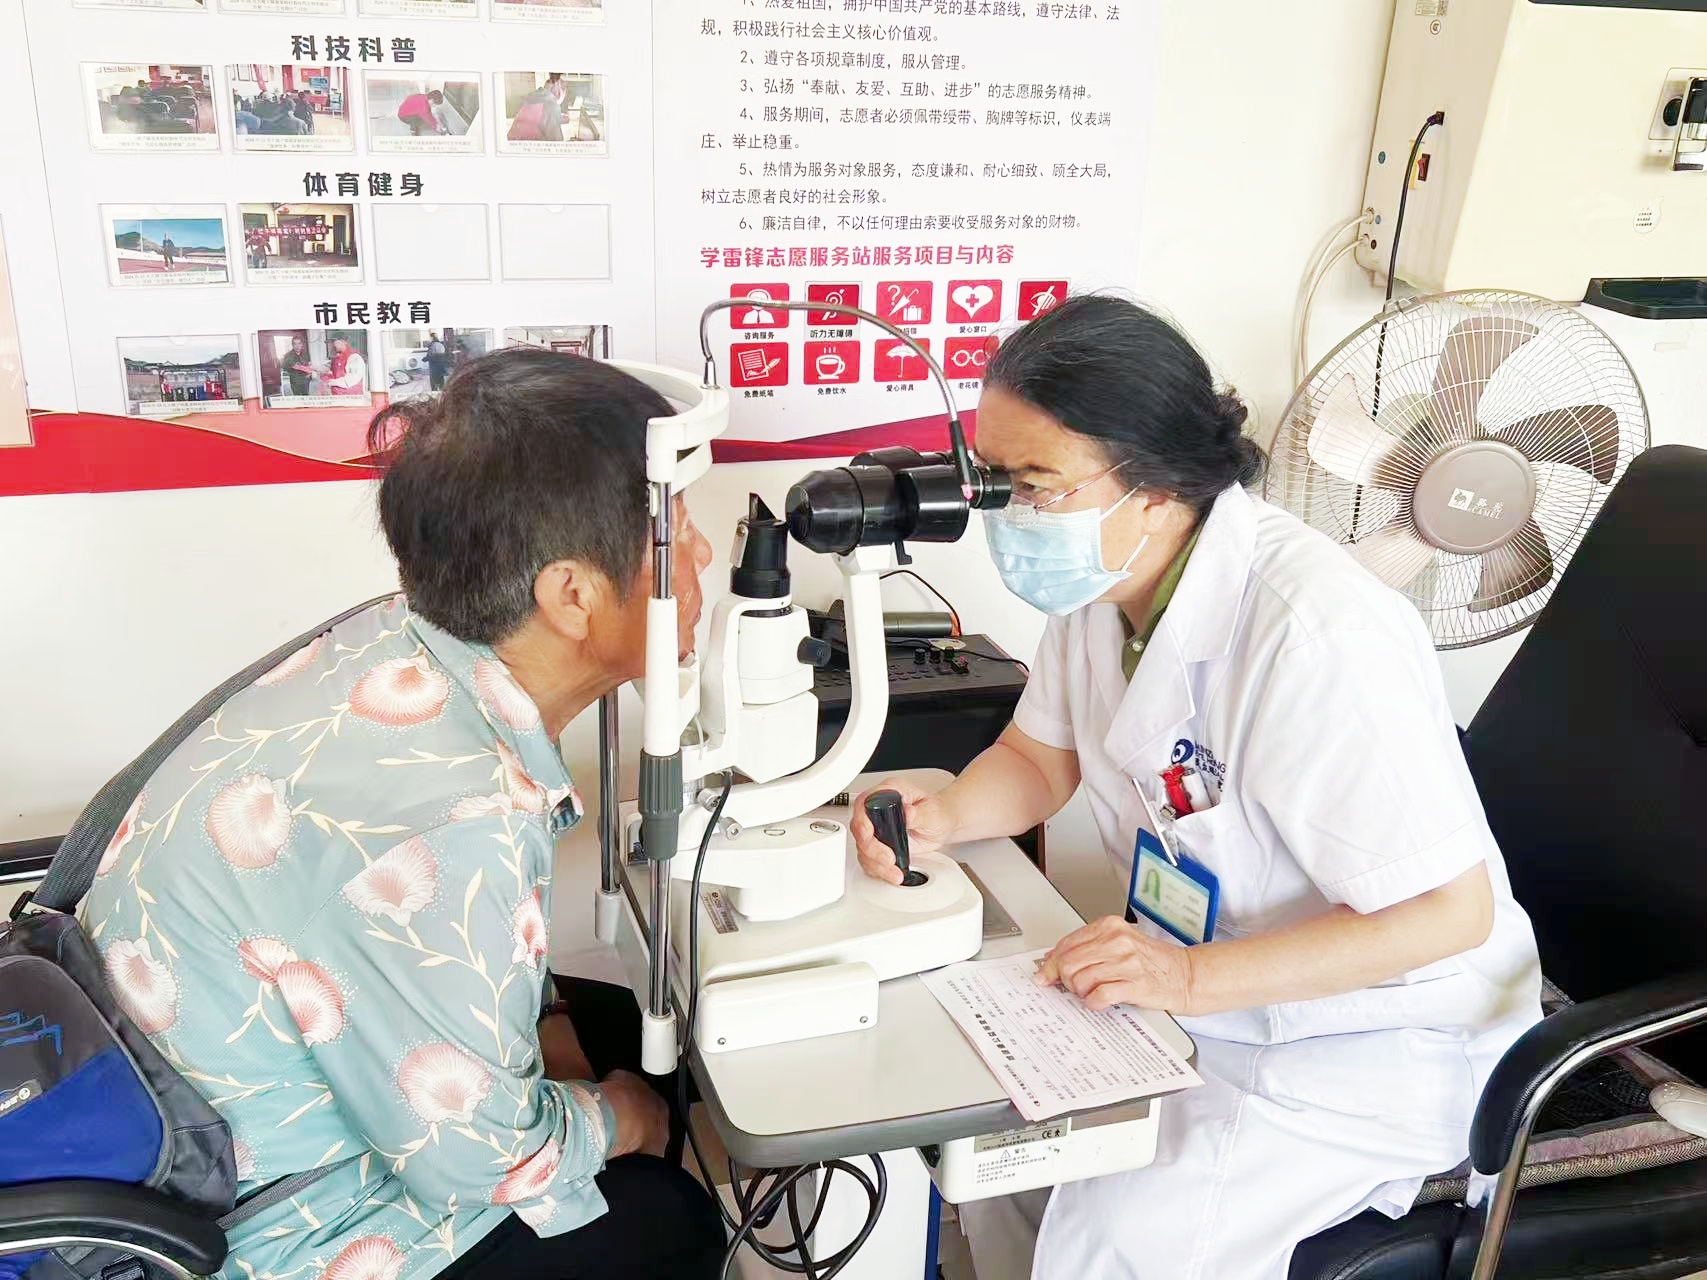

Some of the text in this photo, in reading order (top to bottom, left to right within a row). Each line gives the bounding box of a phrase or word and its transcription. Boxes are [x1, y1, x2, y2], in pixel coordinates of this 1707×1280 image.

[700, 18, 938, 42] 规，积极践行社会主义核心价值观。
[291, 34, 417, 63] 科技科普
[740, 50, 968, 71] 2、遵守各项规章制度，服从管理。
[700, 133, 800, 150] 庄、举止稳重。
[302, 172, 424, 197] 体育健身
[701, 188, 888, 205] 树立志愿者良好的社会形象。
[739, 214, 1081, 231] 6、廉洁自律，不以任何理由索要收受服务对象的财物。
[700, 245, 1014, 268] 学雷锋志愿服务站服务项目与内容
[314, 301, 432, 326] 市民教育
[744, 331, 775, 340] 咨询服务
[810, 329, 853, 339] 听力无障碍
[959, 325, 987, 334] 爱心窗口
[744, 389, 775, 398] 免费纸笔
[817, 387, 847, 396] 免费饮水
[886, 383, 914, 392] 爱心雨具
[1471, 506, 1501, 519] CAMEL
